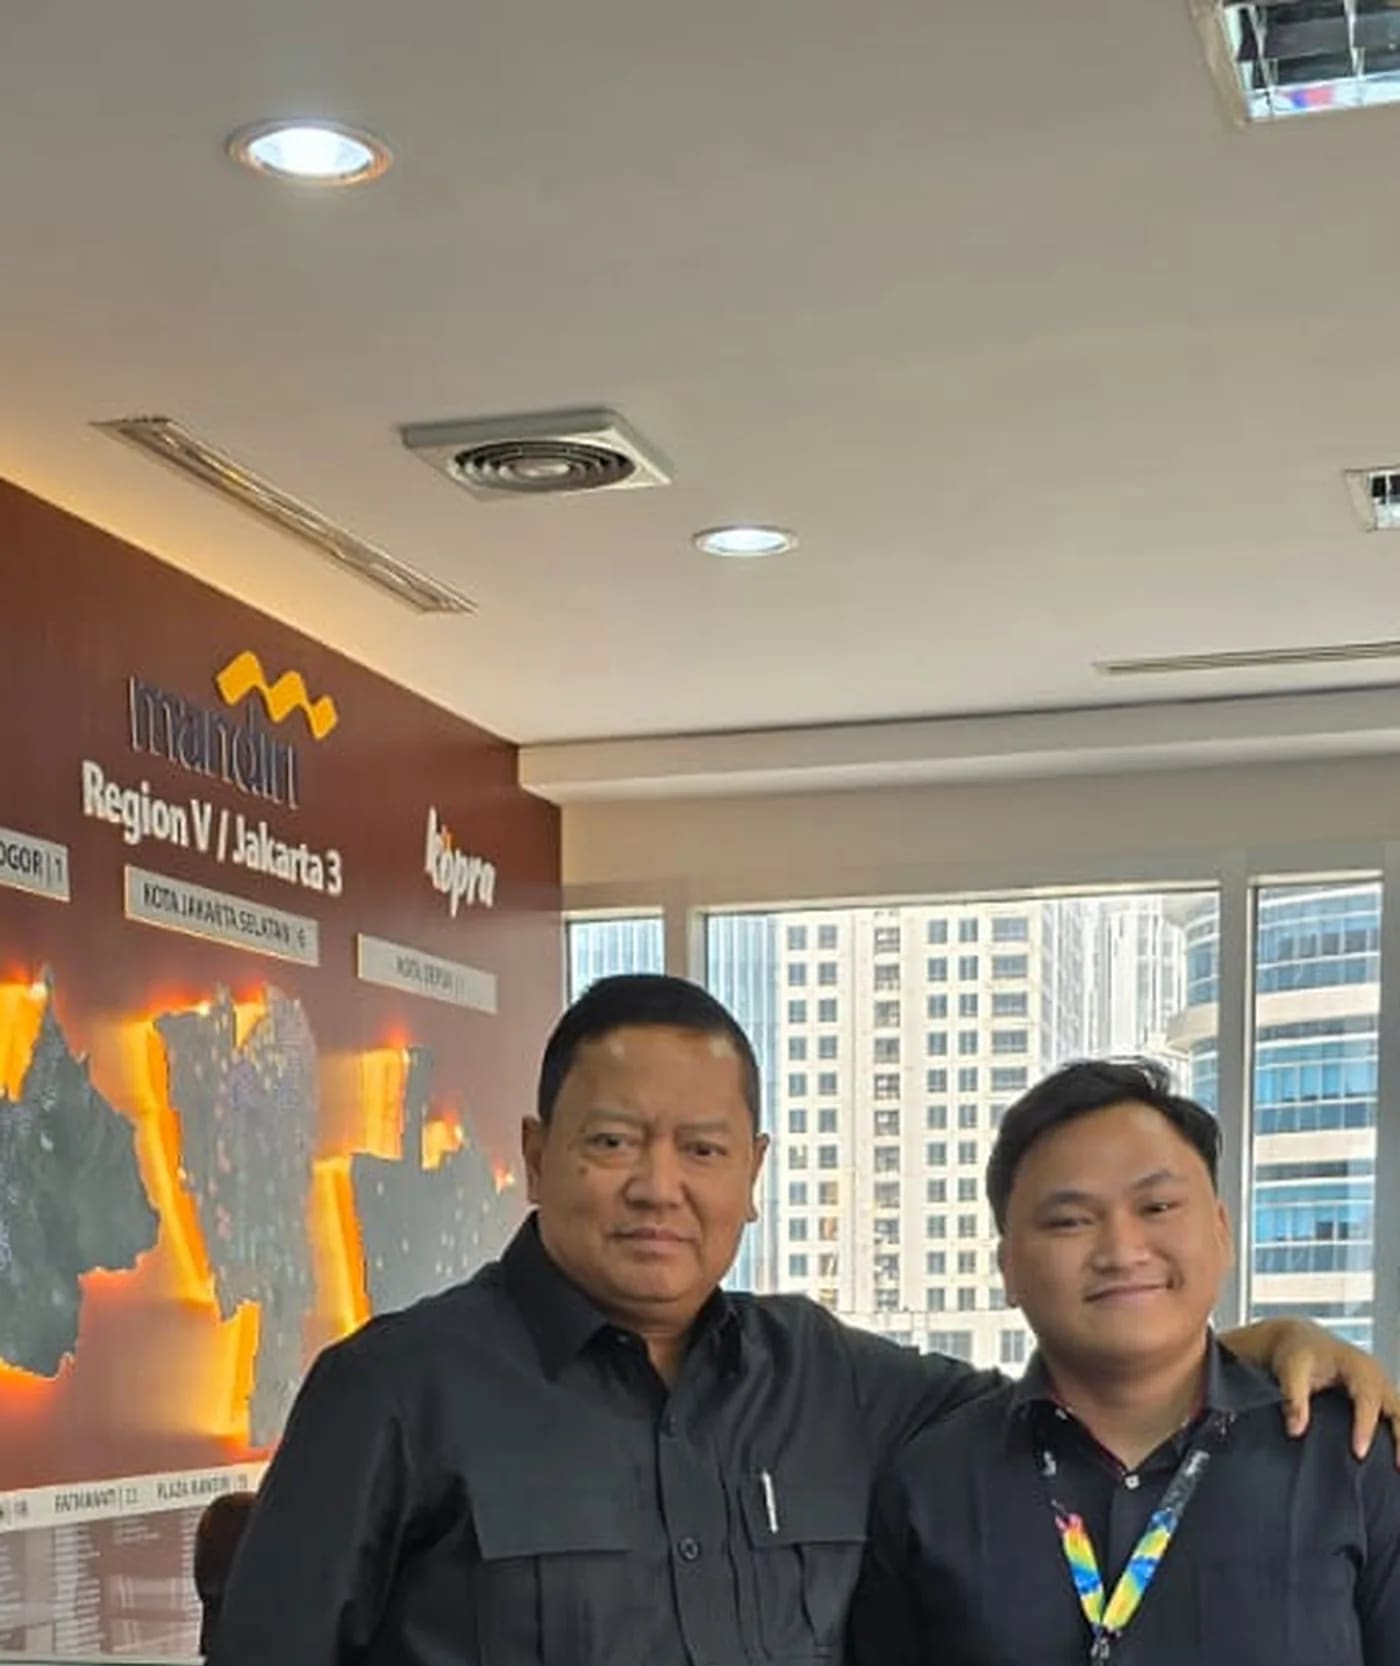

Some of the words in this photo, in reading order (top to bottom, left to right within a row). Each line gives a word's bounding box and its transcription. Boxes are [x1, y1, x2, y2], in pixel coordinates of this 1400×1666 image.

[82, 759, 189, 847] Region
[190, 799, 212, 852] V
[232, 812, 325, 891] Jakarta
[326, 848, 343, 896] 3
